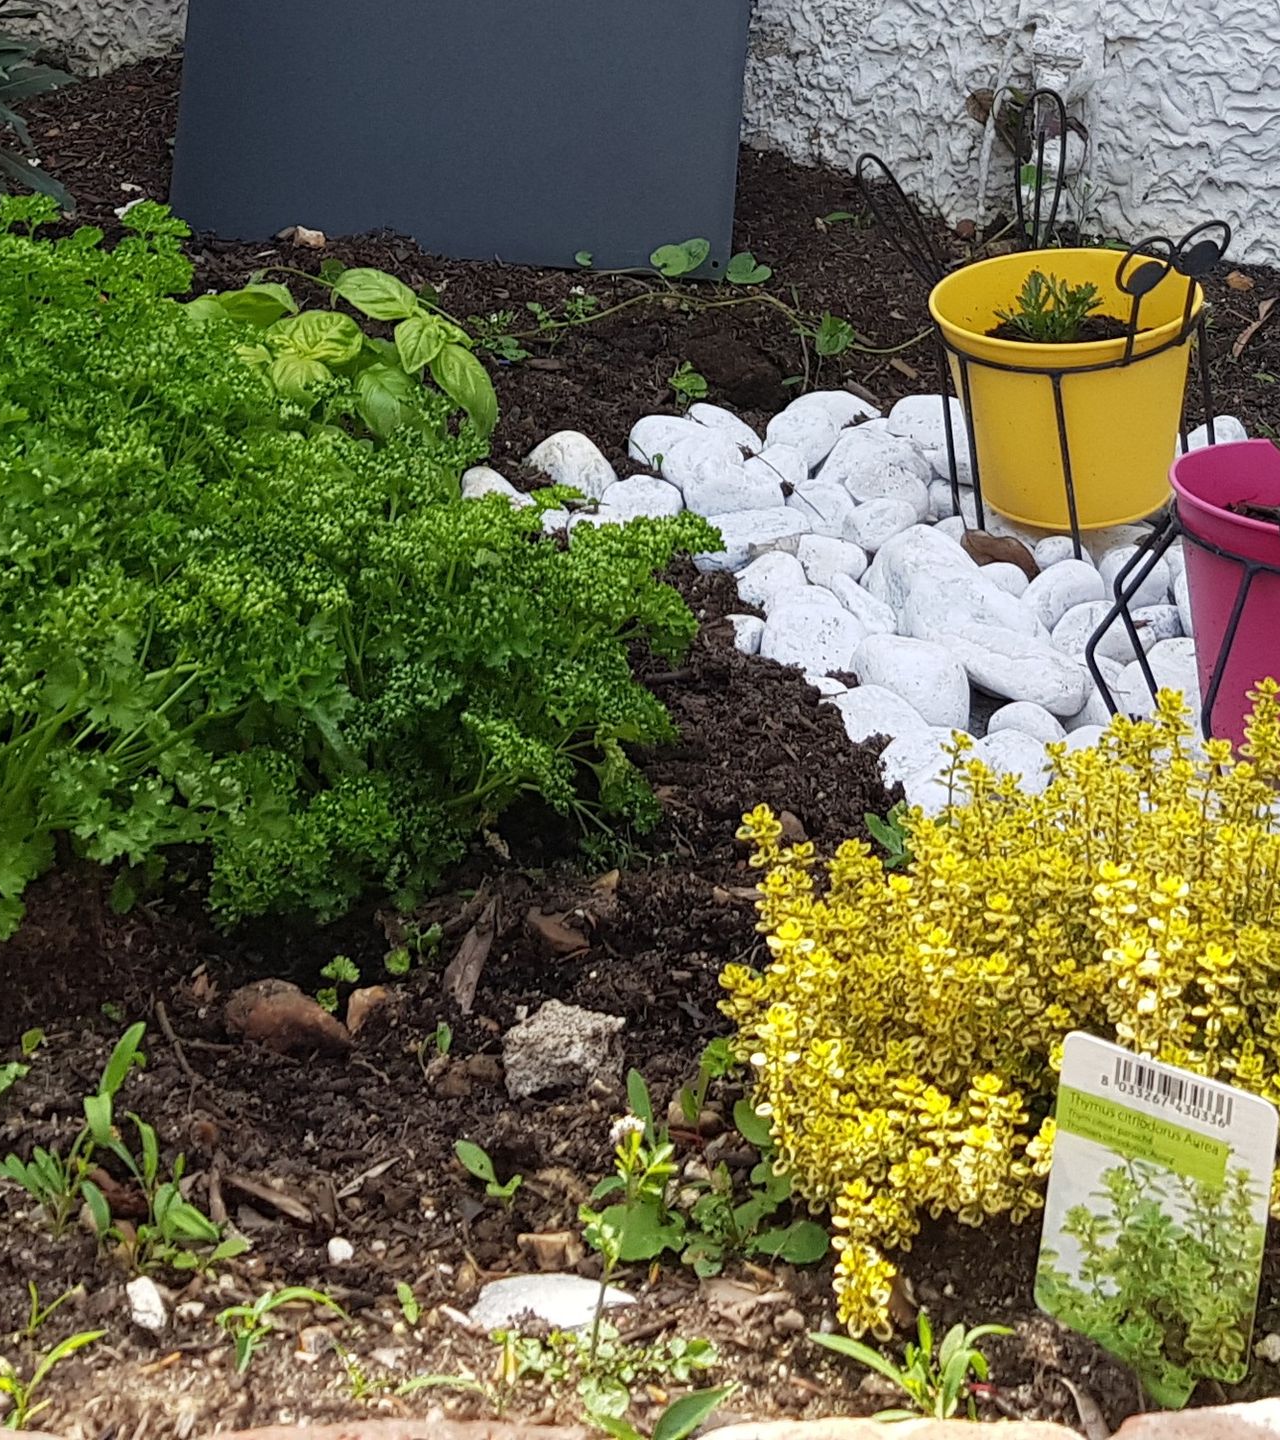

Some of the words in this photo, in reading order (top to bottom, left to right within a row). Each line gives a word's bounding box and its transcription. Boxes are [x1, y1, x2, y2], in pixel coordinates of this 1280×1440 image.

[1070, 1090, 1116, 1118] Thymus
[1183, 1133, 1219, 1155] Aurea
[1100, 1074, 1109, 1086] 8
[1118, 1081, 1169, 1108] 033267
[1175, 1100, 1226, 1129] 430336
